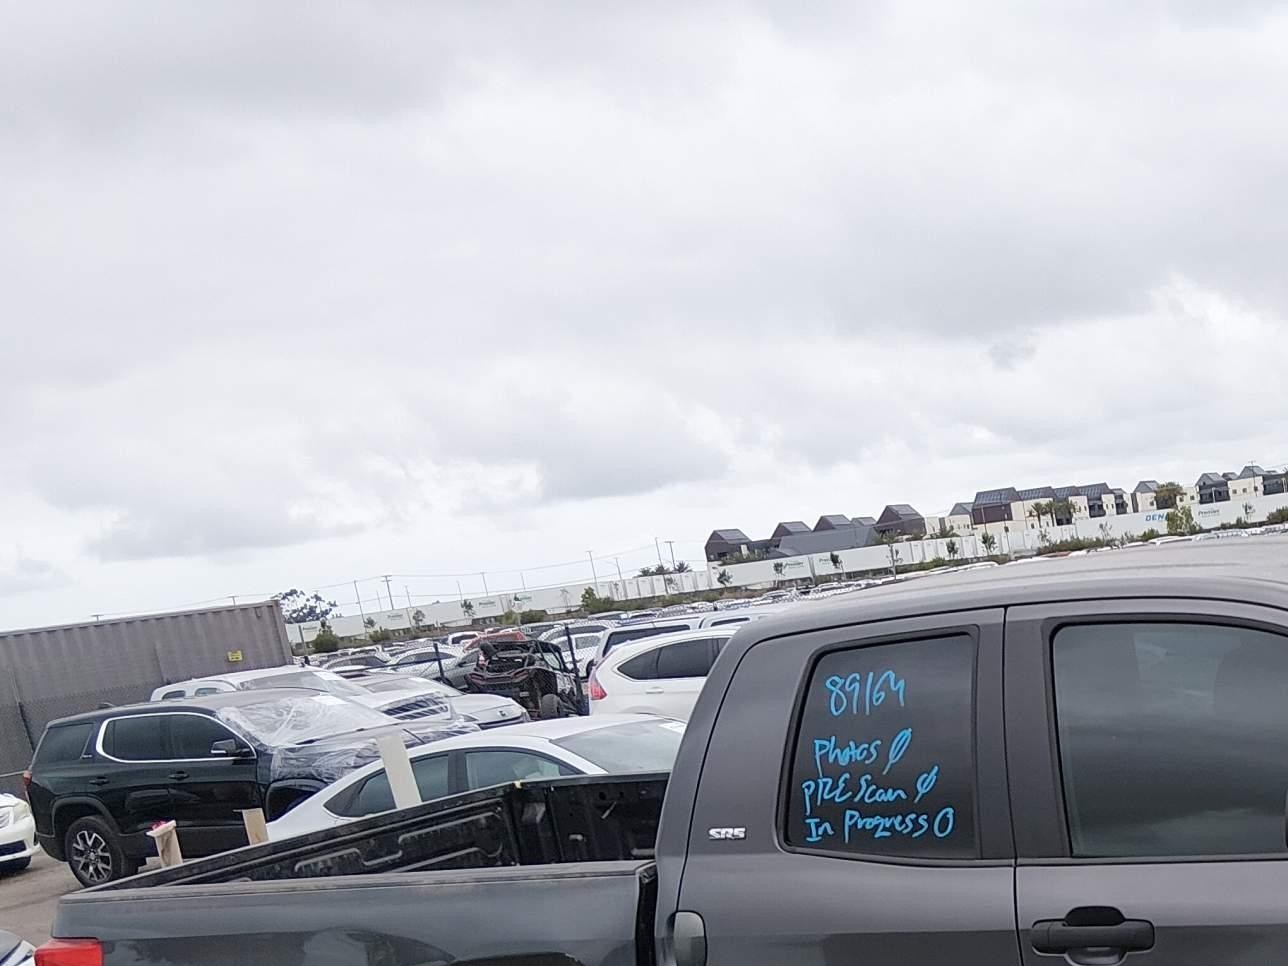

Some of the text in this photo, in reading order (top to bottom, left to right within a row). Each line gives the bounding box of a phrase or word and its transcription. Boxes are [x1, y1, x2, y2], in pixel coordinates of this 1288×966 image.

[853, 774, 908, 804] Scan
[708, 827, 746, 840] SR5
[805, 817, 834, 842] In
